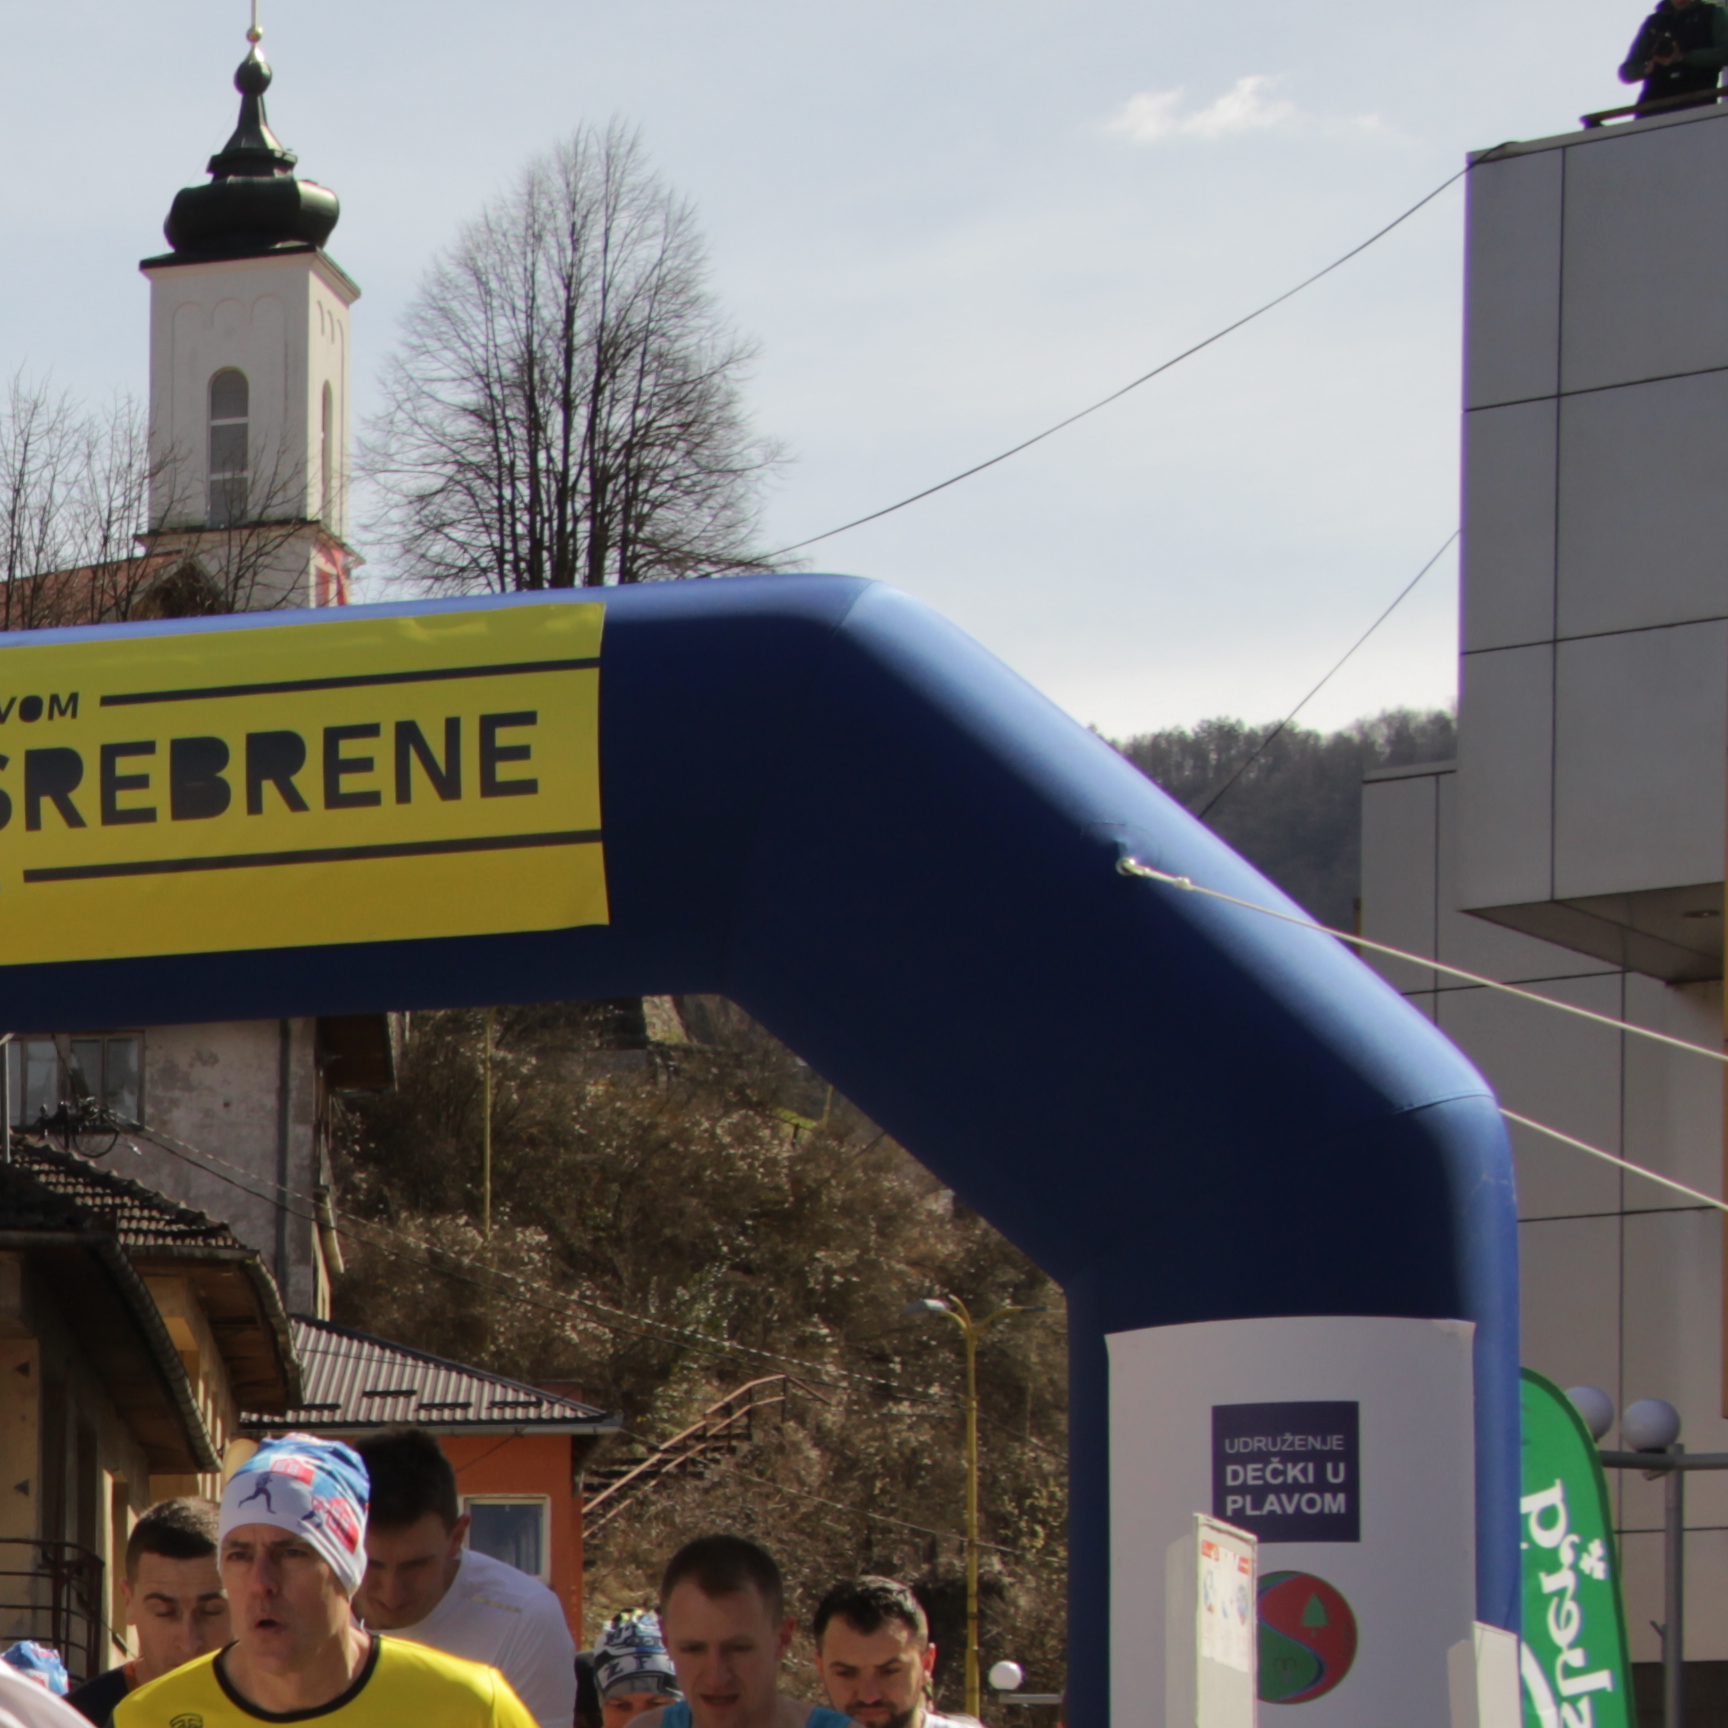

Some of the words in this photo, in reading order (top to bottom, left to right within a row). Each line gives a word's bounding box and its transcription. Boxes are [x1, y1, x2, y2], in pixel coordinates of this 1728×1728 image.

[1225, 1432, 1345, 1454] UDRUŽENJE
[1226, 1457, 1315, 1487] DEČKI
[1326, 1461, 1346, 1484] U
[1226, 1492, 1346, 1517] PLAVOM
